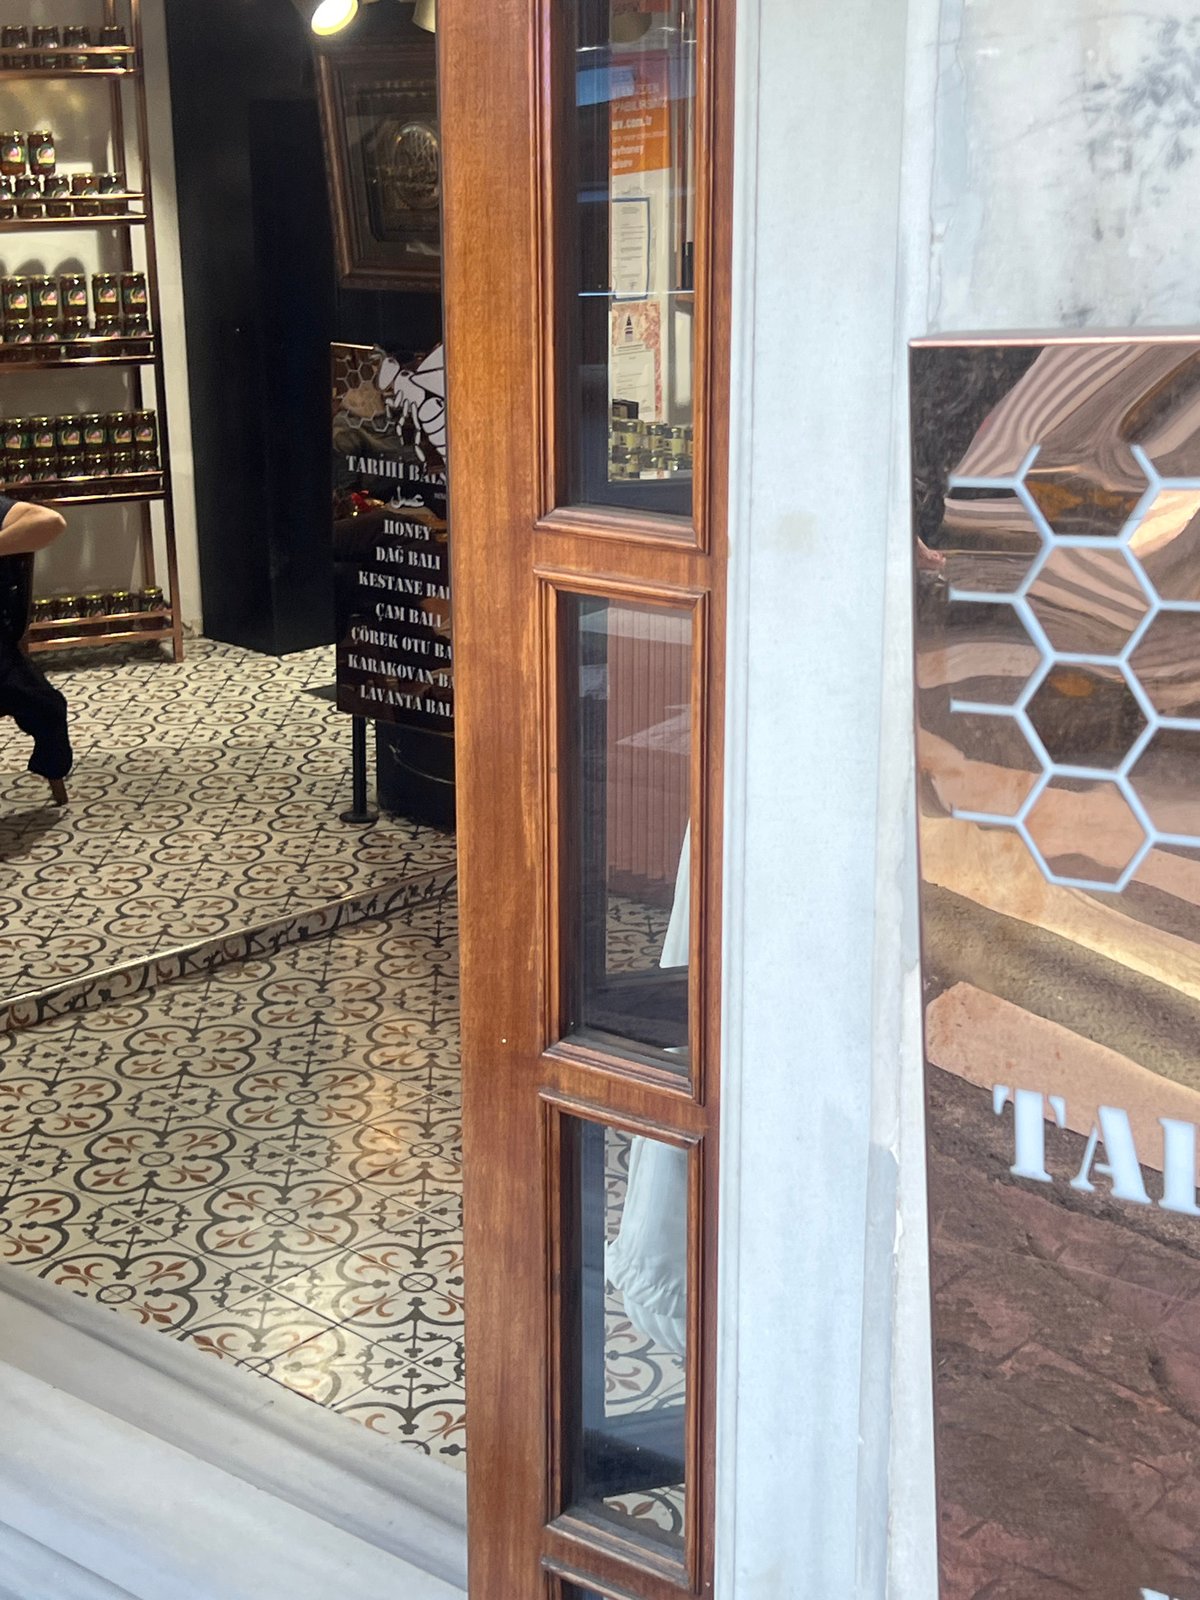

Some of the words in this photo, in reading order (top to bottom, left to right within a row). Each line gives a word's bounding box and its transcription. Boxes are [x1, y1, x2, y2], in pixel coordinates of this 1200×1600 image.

[384, 520, 432, 541] HONEY
[376, 546, 404, 563] DAĞ
[408, 551, 440, 570] BALI
[359, 570, 423, 596] KESTANE
[426, 582, 450, 600] BAL
[375, 602, 405, 622] ÇAM
[409, 608, 442, 628] BALI
[351, 625, 398, 649] ÇÖREK
[402, 636, 431, 655] OTU
[434, 642, 452, 660] BA
[348, 653, 434, 685] KARAKOVAN
[360, 684, 422, 711] LAVANTA
[426, 698, 454, 718] BAL
